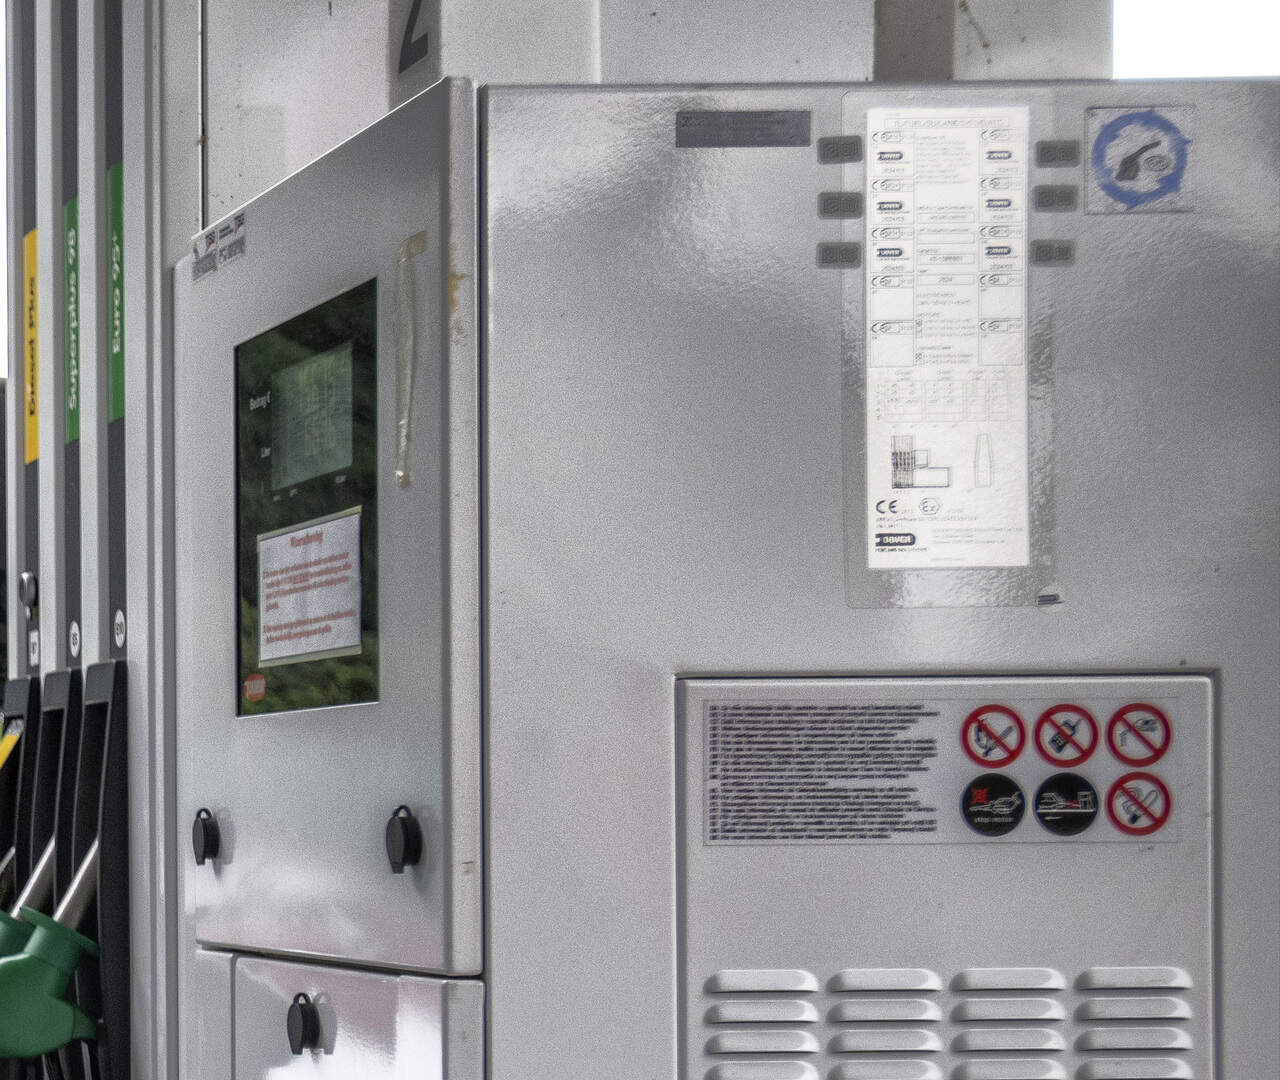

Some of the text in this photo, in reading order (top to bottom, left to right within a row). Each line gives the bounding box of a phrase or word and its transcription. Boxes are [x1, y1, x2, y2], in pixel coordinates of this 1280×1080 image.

[27, 276, 36, 416] Diesel Plus
[67, 228, 78, 410] Superplus 98
[112, 287, 121, 354] Euro
